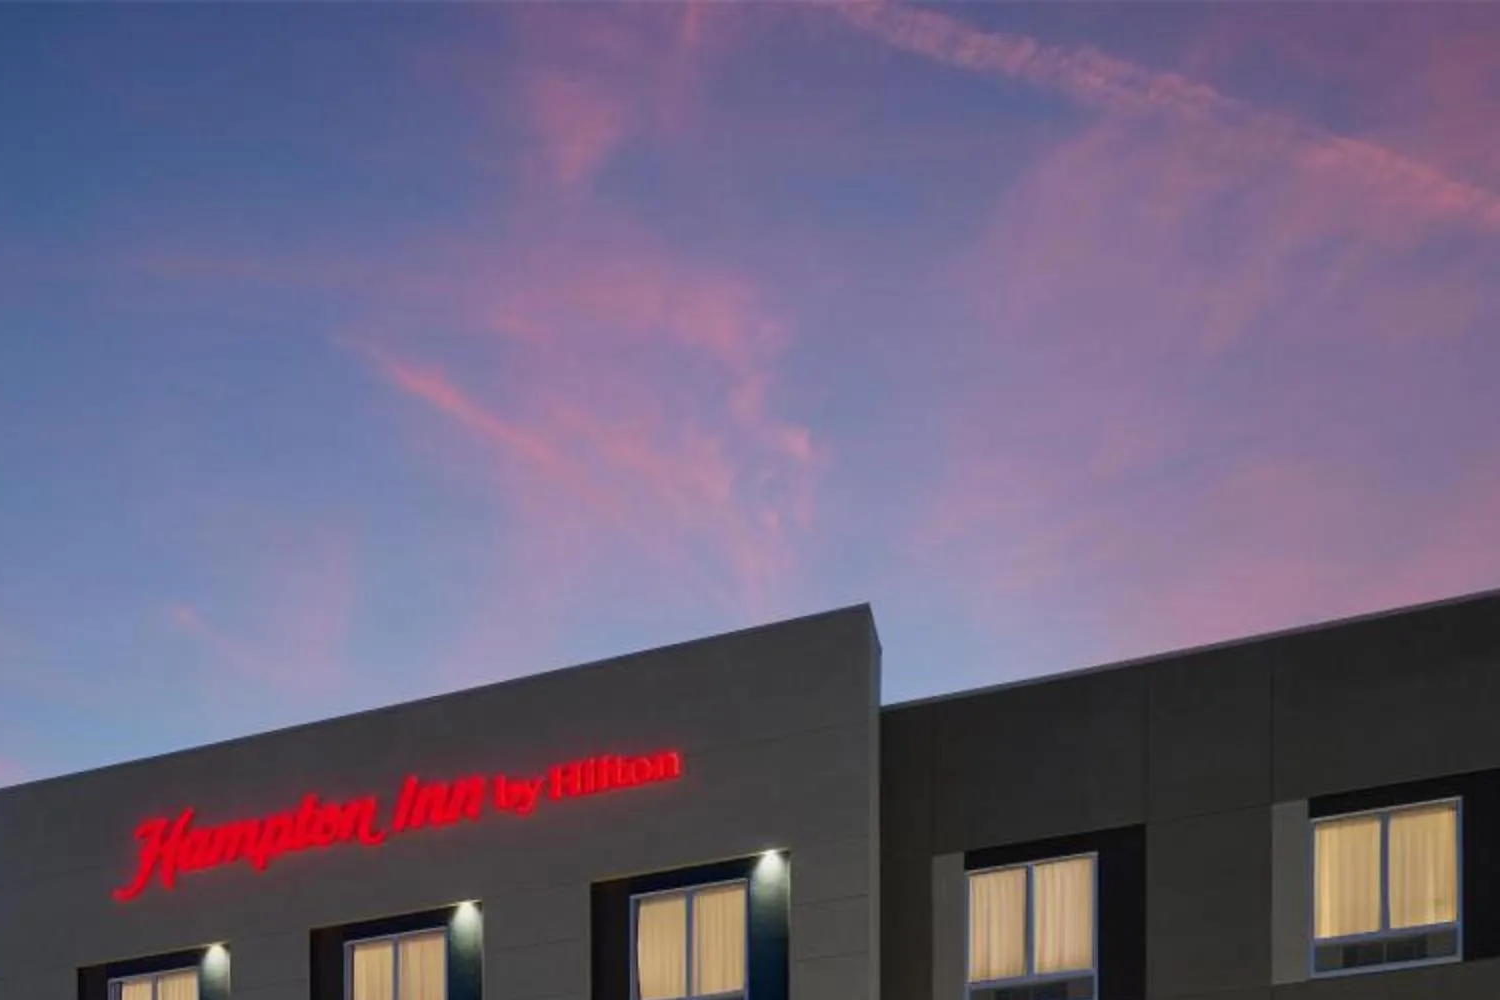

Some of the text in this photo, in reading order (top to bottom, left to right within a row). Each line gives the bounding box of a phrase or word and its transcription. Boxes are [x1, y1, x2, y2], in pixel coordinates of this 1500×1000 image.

[111, 750, 682, 902] Hampton Inn by Hilton
